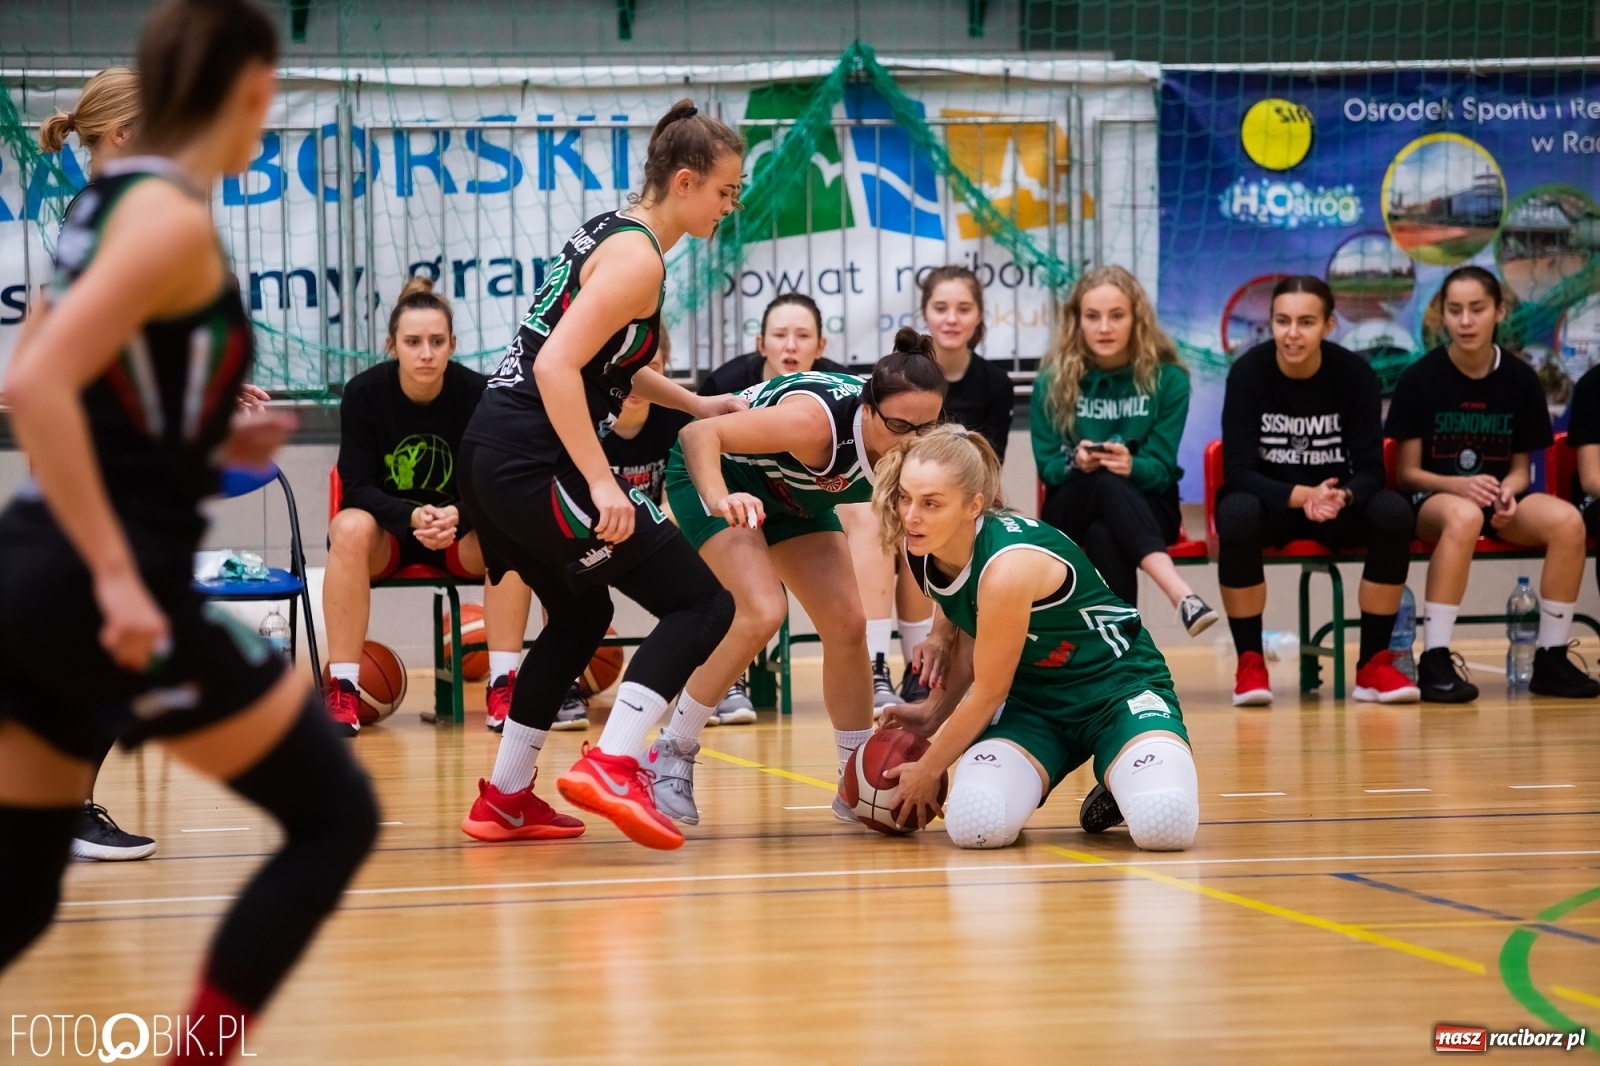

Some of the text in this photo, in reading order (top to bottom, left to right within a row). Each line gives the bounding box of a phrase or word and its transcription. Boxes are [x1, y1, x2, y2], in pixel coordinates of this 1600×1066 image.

[1343, 96, 1455, 122] Ośrodek
[1462, 96, 1547, 125] Sportu
[1530, 136, 1555, 154] w
[1434, 411, 1514, 435] SOSNOWIEC
[1258, 446, 1345, 465] BASKETBALL
